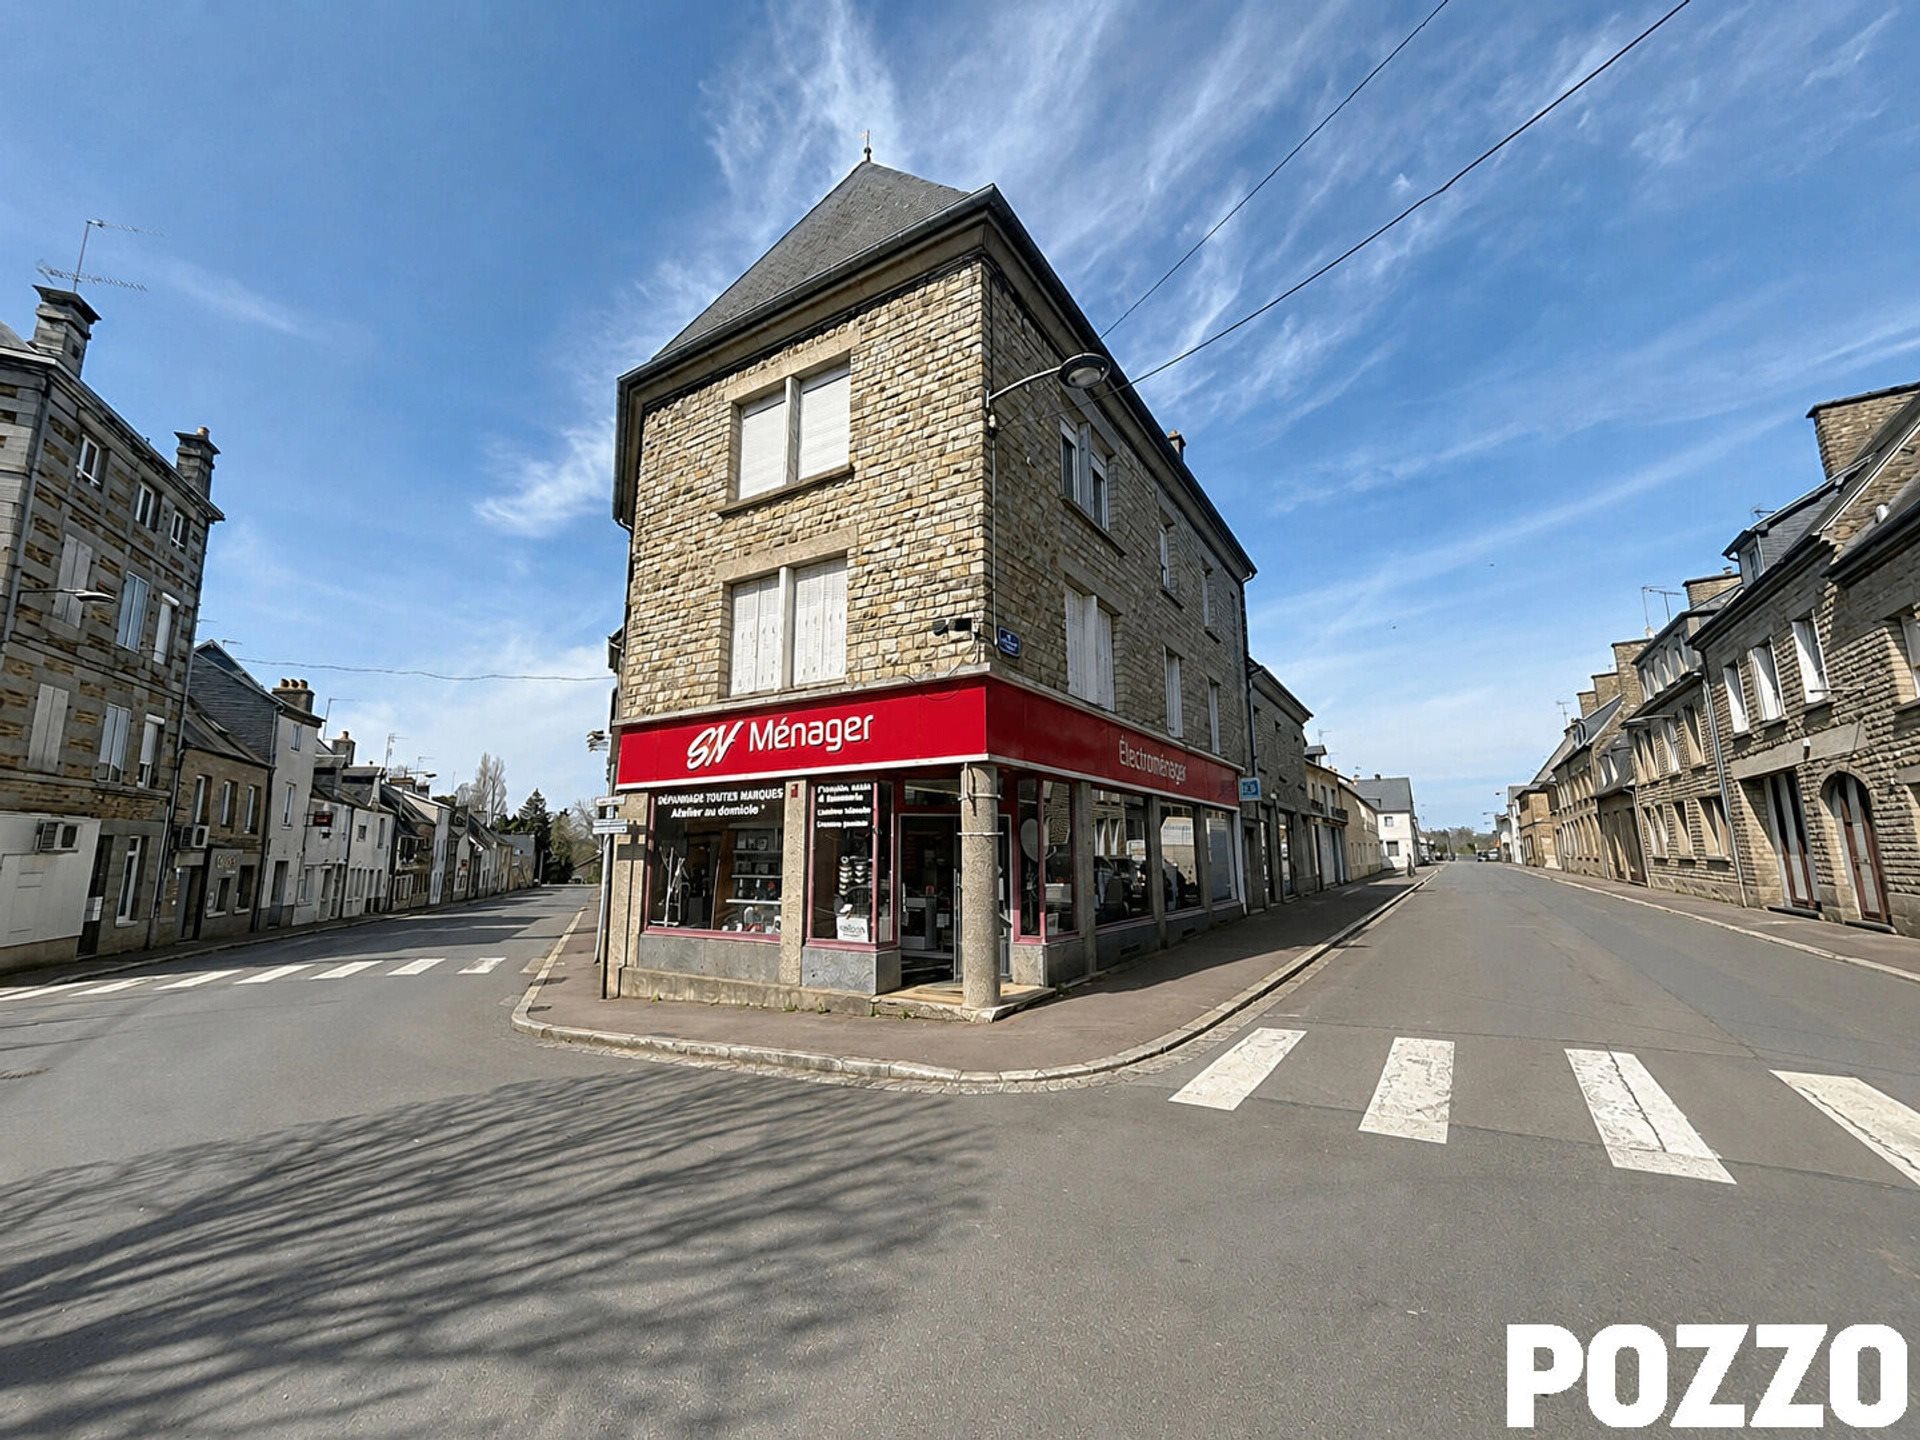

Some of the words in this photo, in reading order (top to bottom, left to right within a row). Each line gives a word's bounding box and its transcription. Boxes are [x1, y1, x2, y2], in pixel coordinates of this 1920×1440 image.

[749, 714, 875, 753] Ménager
[1119, 733, 1187, 787] Électroménager
[706, 791, 738, 803] TOUTES
[740, 788, 784, 801] MARQUES
